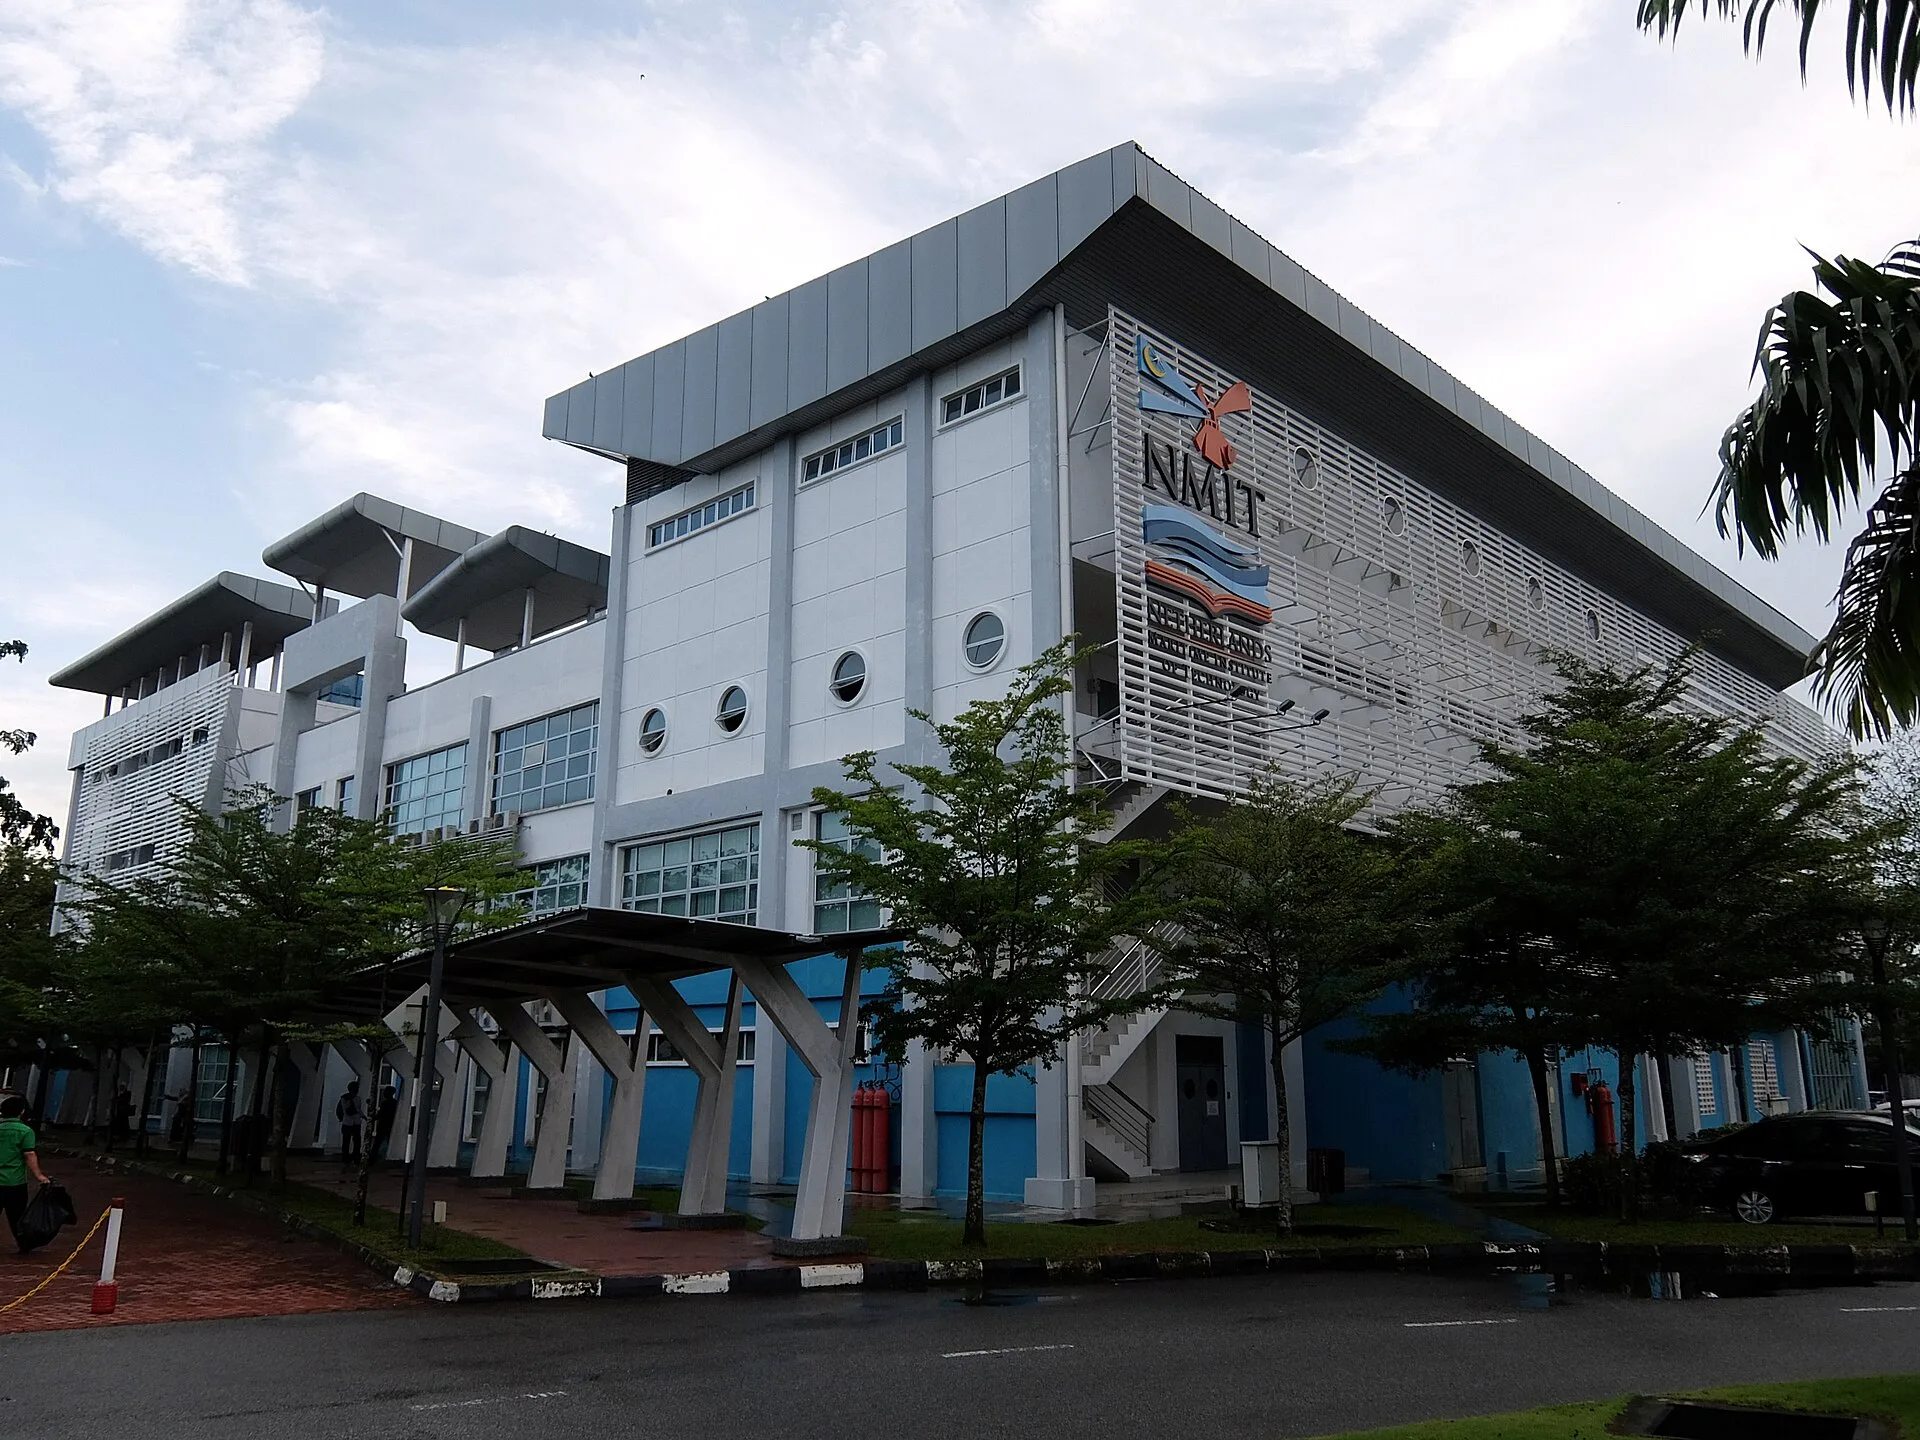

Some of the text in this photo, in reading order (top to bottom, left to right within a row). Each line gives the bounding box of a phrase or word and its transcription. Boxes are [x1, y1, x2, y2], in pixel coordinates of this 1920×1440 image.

[1143, 433, 1265, 538] NMIT
[1148, 600, 1272, 662] NETHERLANDS
[1149, 630, 1272, 684] MARITIME INSTITUTE
[1162, 659, 1260, 699] OF TECHNOGY
